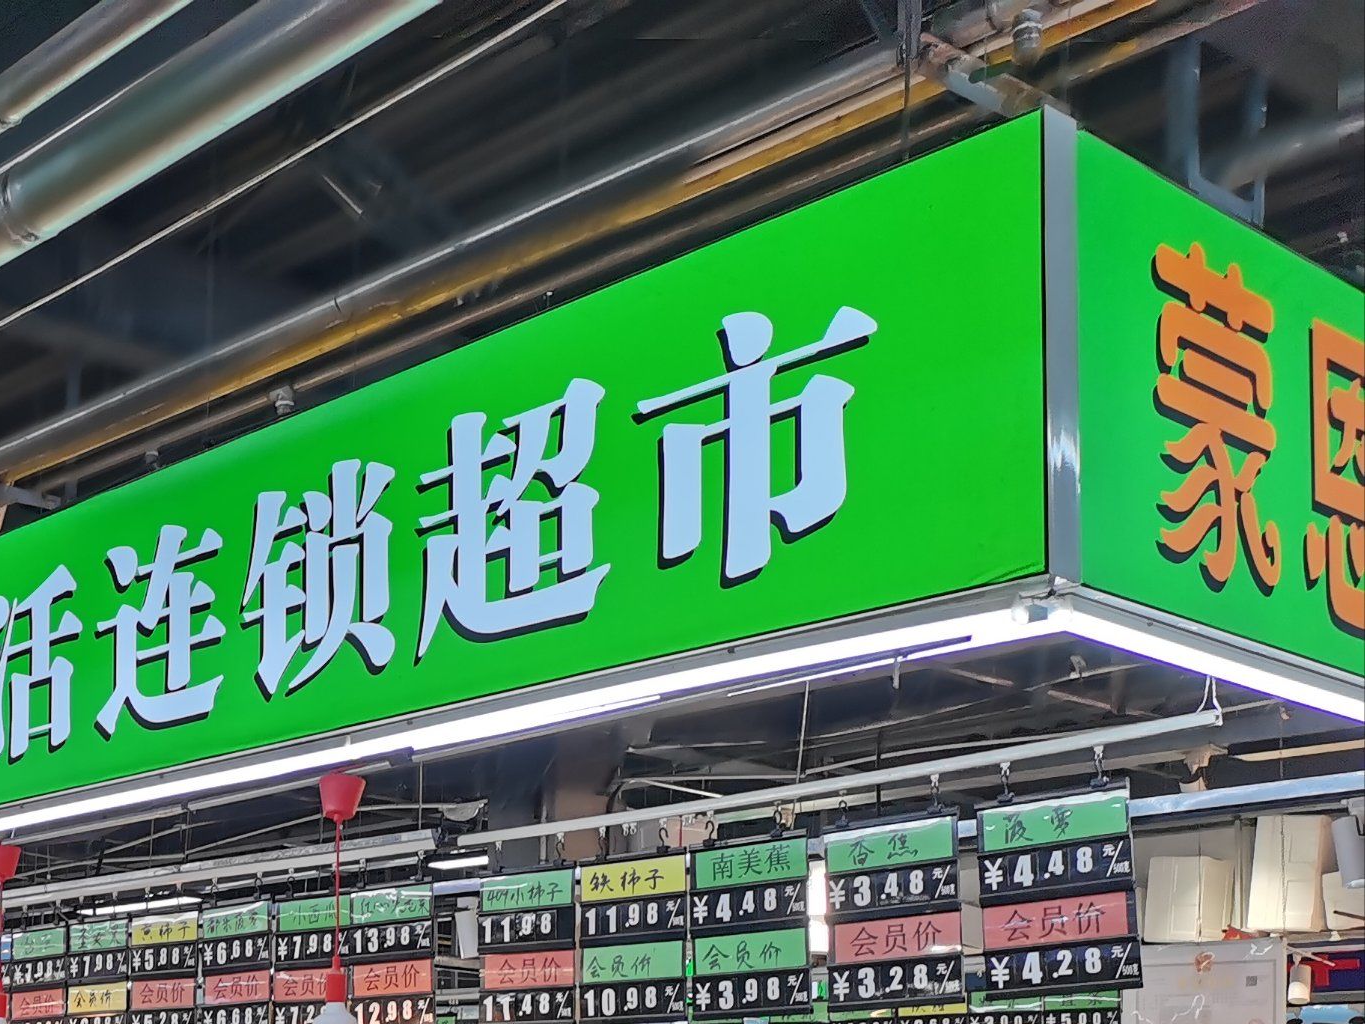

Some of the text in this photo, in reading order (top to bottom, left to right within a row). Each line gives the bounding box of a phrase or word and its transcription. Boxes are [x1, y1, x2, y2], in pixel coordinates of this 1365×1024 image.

[710, 843, 791, 881] 南美蕉
[984, 846, 1093, 890] ¥4.48
[590, 867, 664, 894] 铁柿子
[829, 869, 923, 909] ¥3.48
[585, 902, 658, 936] 11.98
[693, 888, 776, 924] ¥4.48
[482, 913, 552, 943] 11.98
[1001, 901, 1106, 942] 会员价
[204, 939, 253, 965] ¥6.68
[278, 933, 332, 960] ¥7.98
[353, 926, 410, 954] 13.98
[850, 920, 942, 957] 会员价
[587, 954, 651, 977] 会员价
[702, 940, 782, 970] 会员价
[990, 947, 1102, 988] ¥4.28
[364, 964, 420, 991] 会员价
[498, 957, 561, 984] 会员价
[833, 963, 928, 1001] ¥3.28
[74, 989, 112, 1007] 会员价
[140, 982, 185, 1004] 会员价
[214, 974, 258, 999] 会员价
[584, 985, 657, 1017] 10.98
[695, 976, 780, 1010] ¥3.98
[21, 995, 53, 1016] 会员价
[483, 993, 550, 1021] 11.48
